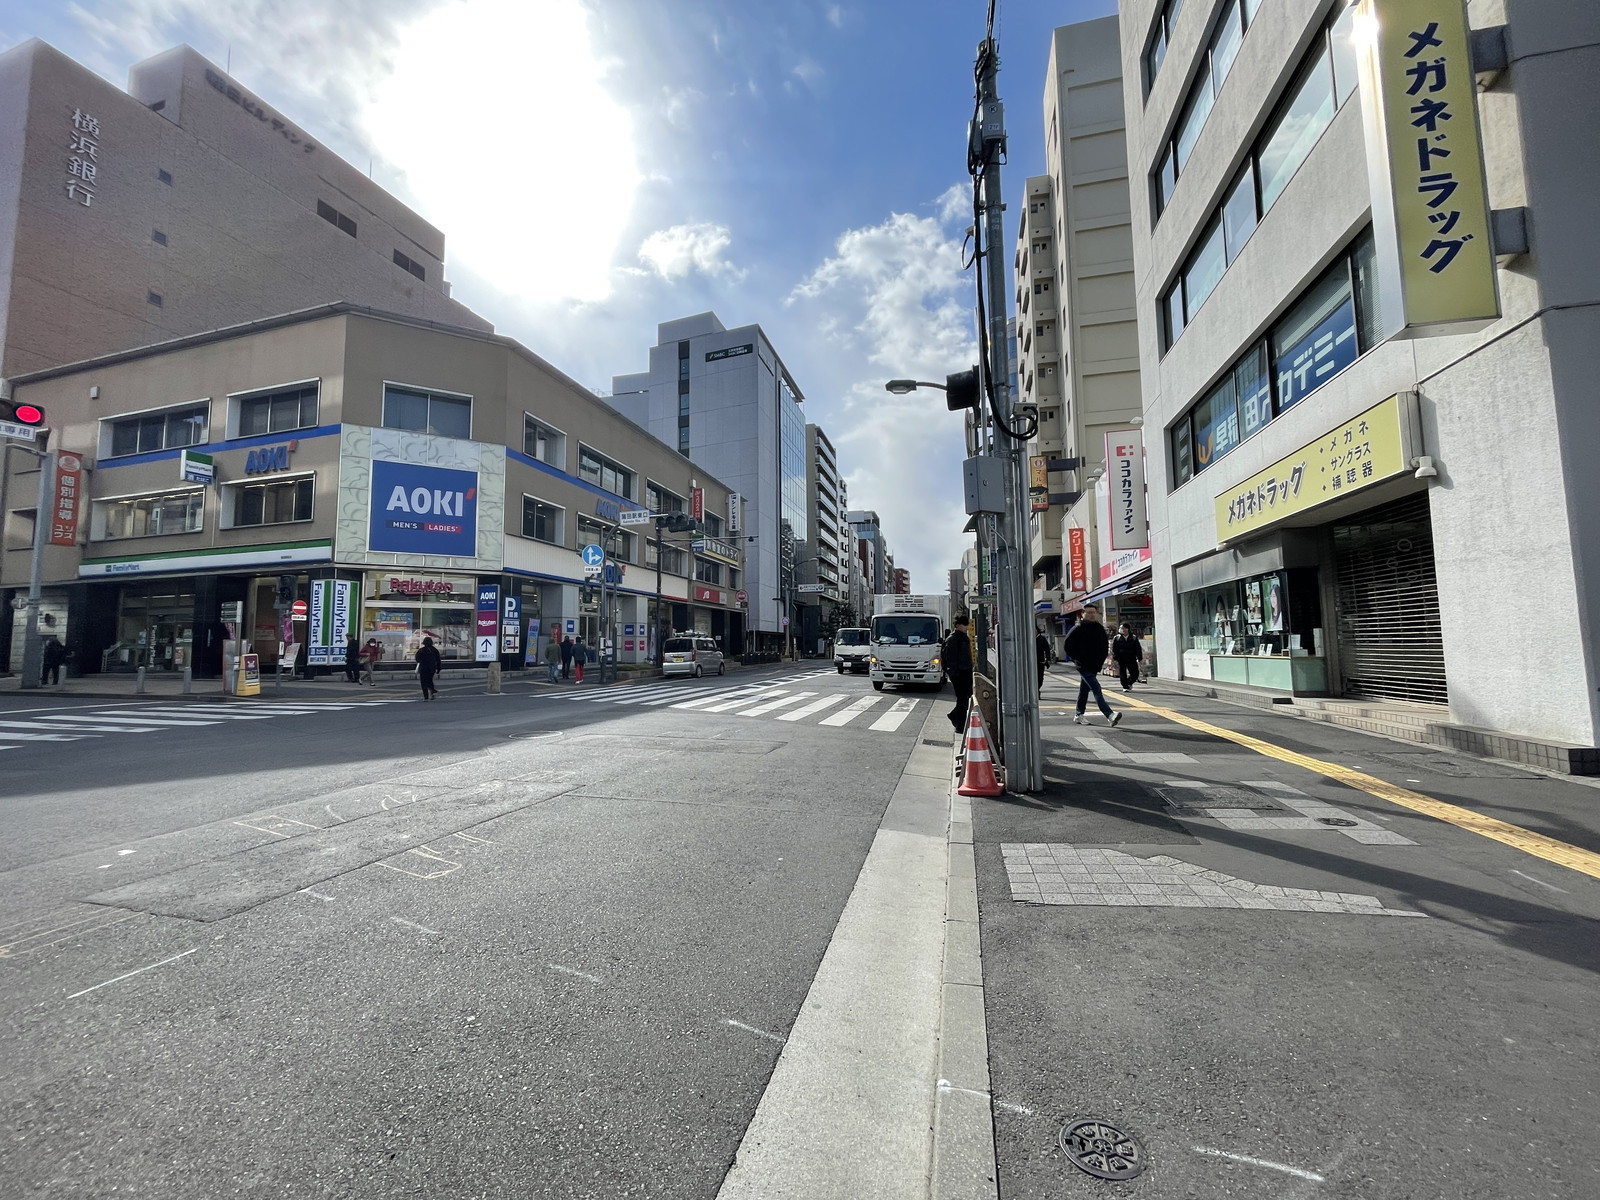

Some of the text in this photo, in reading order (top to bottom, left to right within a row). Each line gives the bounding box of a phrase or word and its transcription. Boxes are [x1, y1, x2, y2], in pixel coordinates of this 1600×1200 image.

[66, 108, 101, 207] 横浜銀行
[1403, 22, 1474, 274] メガネドラッグ
[1215, 325, 1355, 452] 早稲田アカデミー
[1330, 420, 1370, 452] メガネ
[245, 446, 289, 474] AOKI
[1330, 442, 1371, 471] サングラス
[1332, 461, 1373, 491] 補聴器
[386, 485, 464, 517] AOKI
[1120, 459, 1135, 534] ココカラファイン
[1227, 461, 1307, 526] メガネドラッグ
[392, 521, 458, 532] MEN'S LADIES'
[1071, 530, 1083, 577] クリーニング
[390, 578, 454, 594] Rakuten
[480, 592, 496, 600] AOKI
[312, 583, 323, 644] FamilyMart
[335, 583, 348, 644] FamilyMart
[504, 597, 516, 618] P
